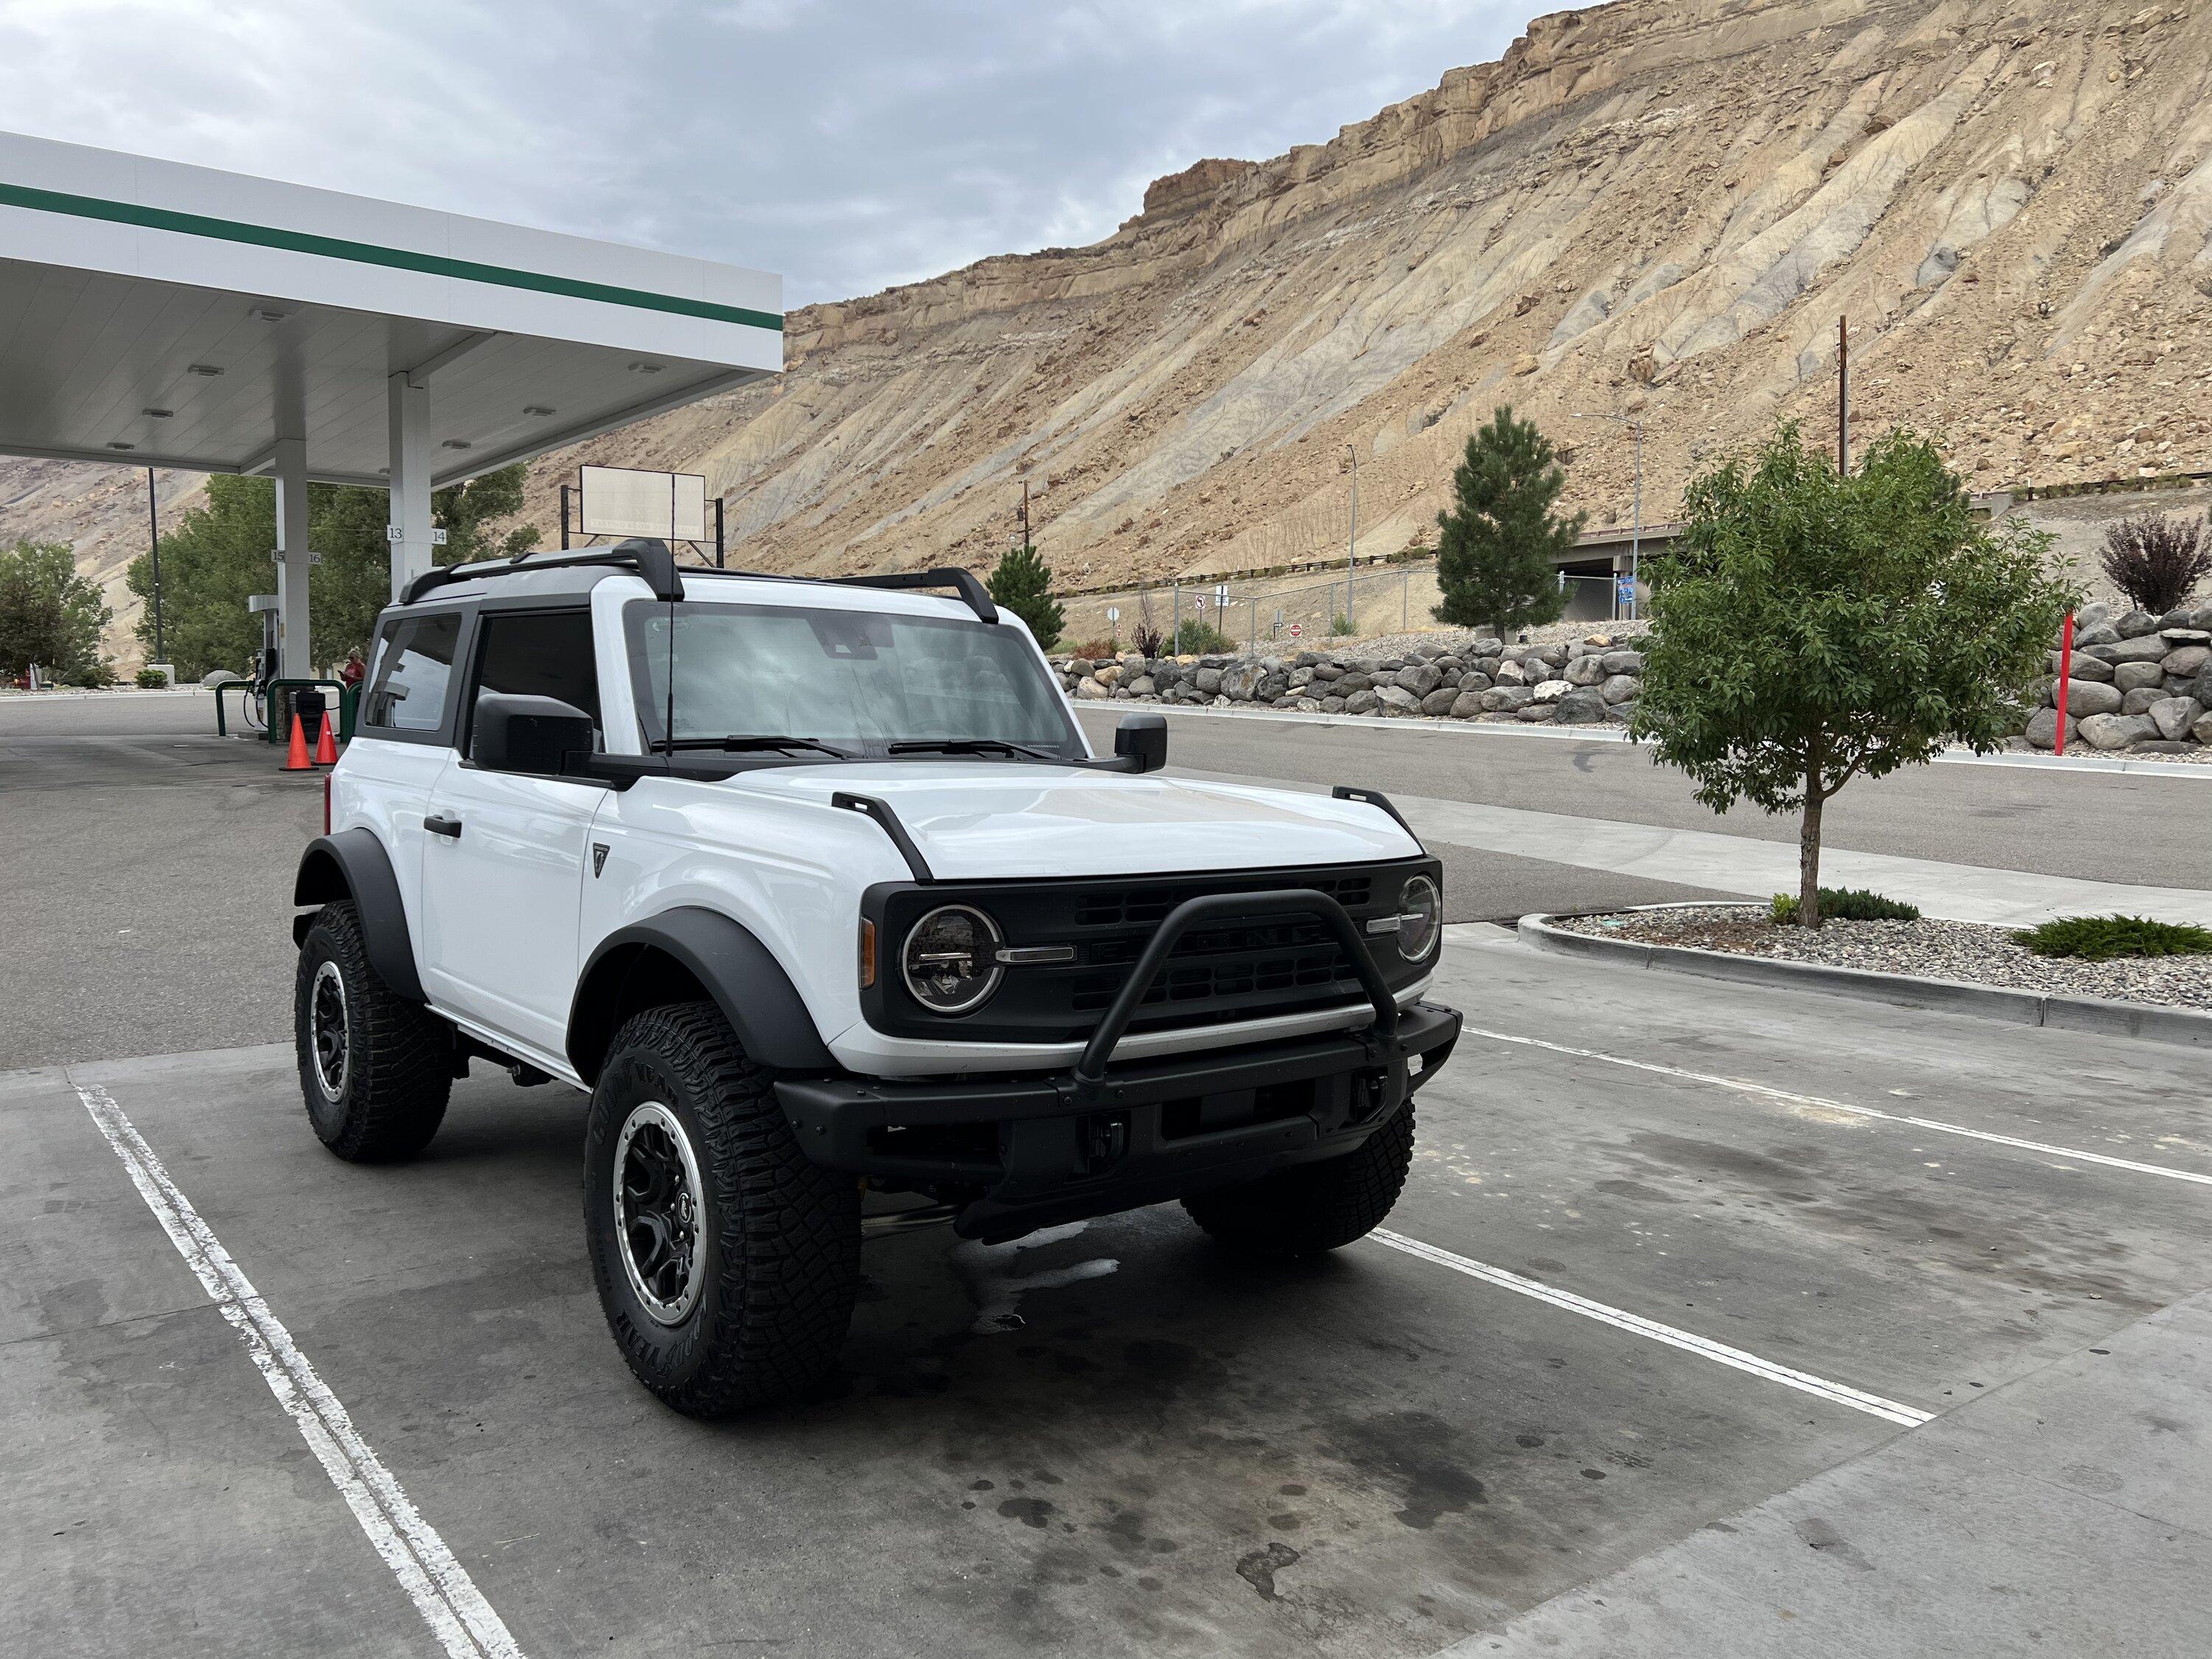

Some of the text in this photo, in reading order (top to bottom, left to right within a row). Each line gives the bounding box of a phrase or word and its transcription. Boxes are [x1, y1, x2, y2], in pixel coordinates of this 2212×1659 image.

[389, 528, 403, 539] 13
[433, 532, 445, 542] 14
[273, 551, 285, 561] 15
[309, 554, 321, 563] 16
